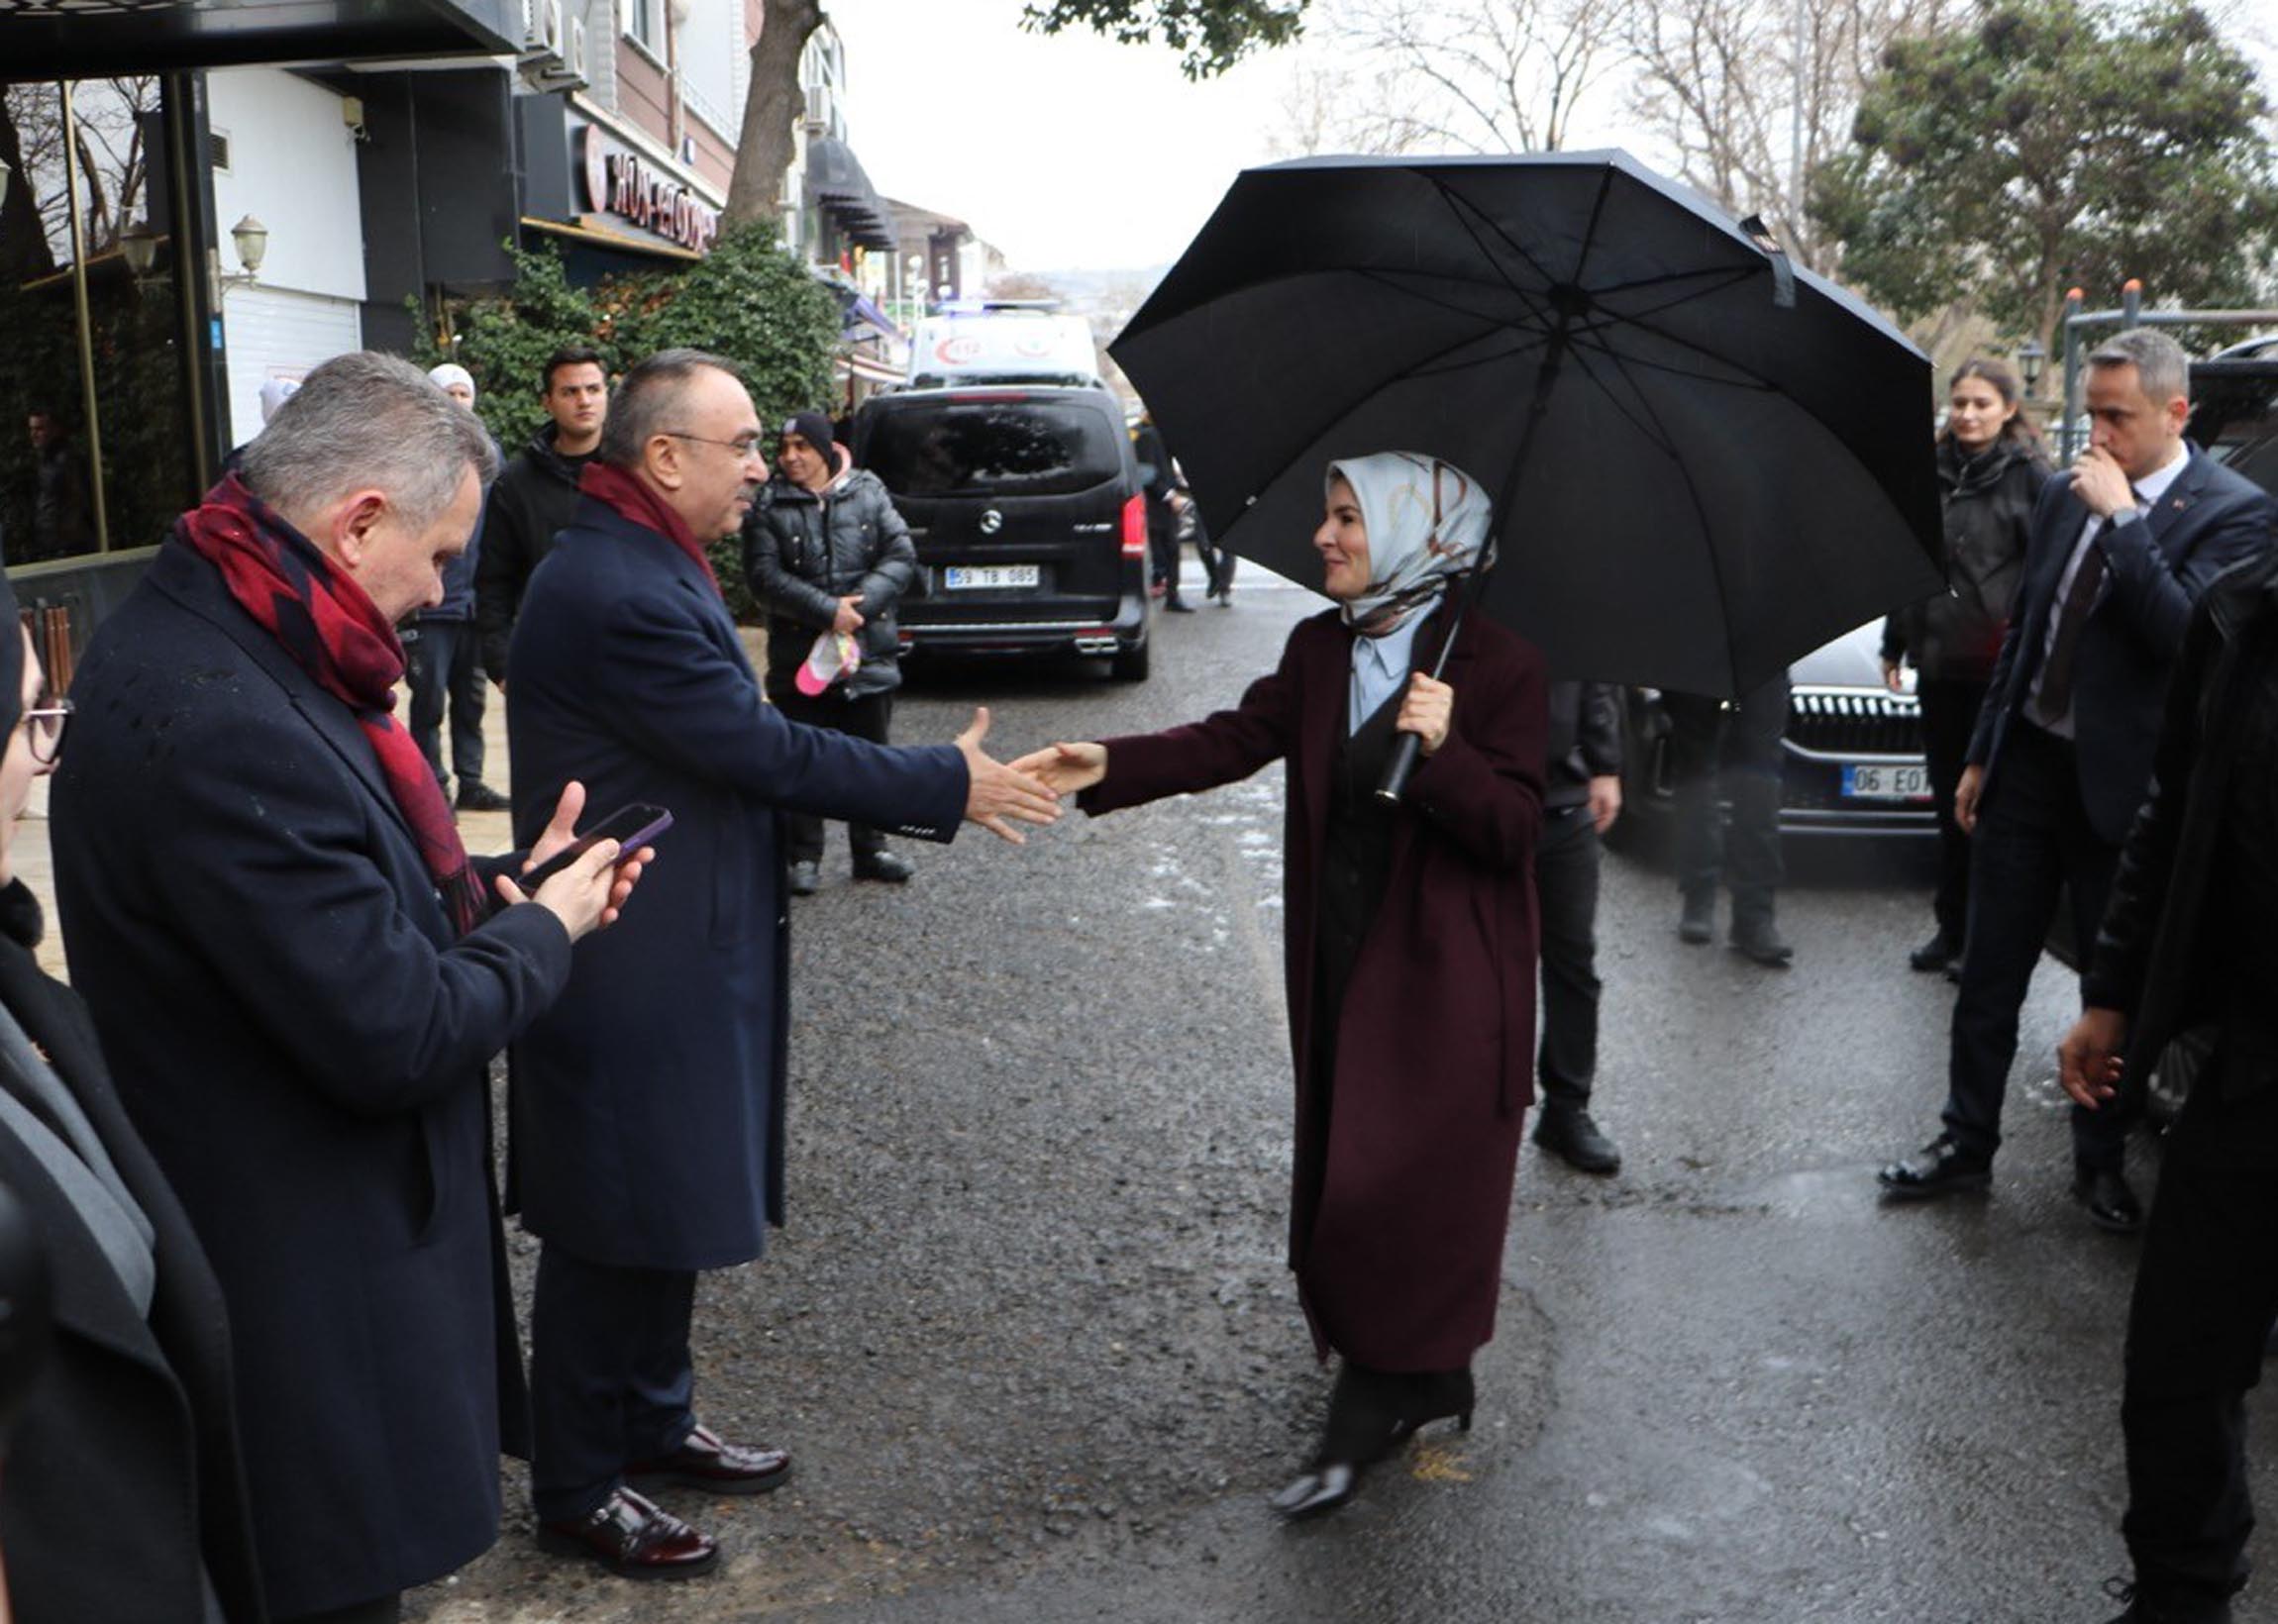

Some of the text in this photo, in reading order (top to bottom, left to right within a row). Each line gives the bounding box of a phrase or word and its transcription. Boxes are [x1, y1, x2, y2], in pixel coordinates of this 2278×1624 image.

[955, 568, 972, 584] 59
[983, 569, 998, 584] TB
[1854, 768, 1880, 791] 06
